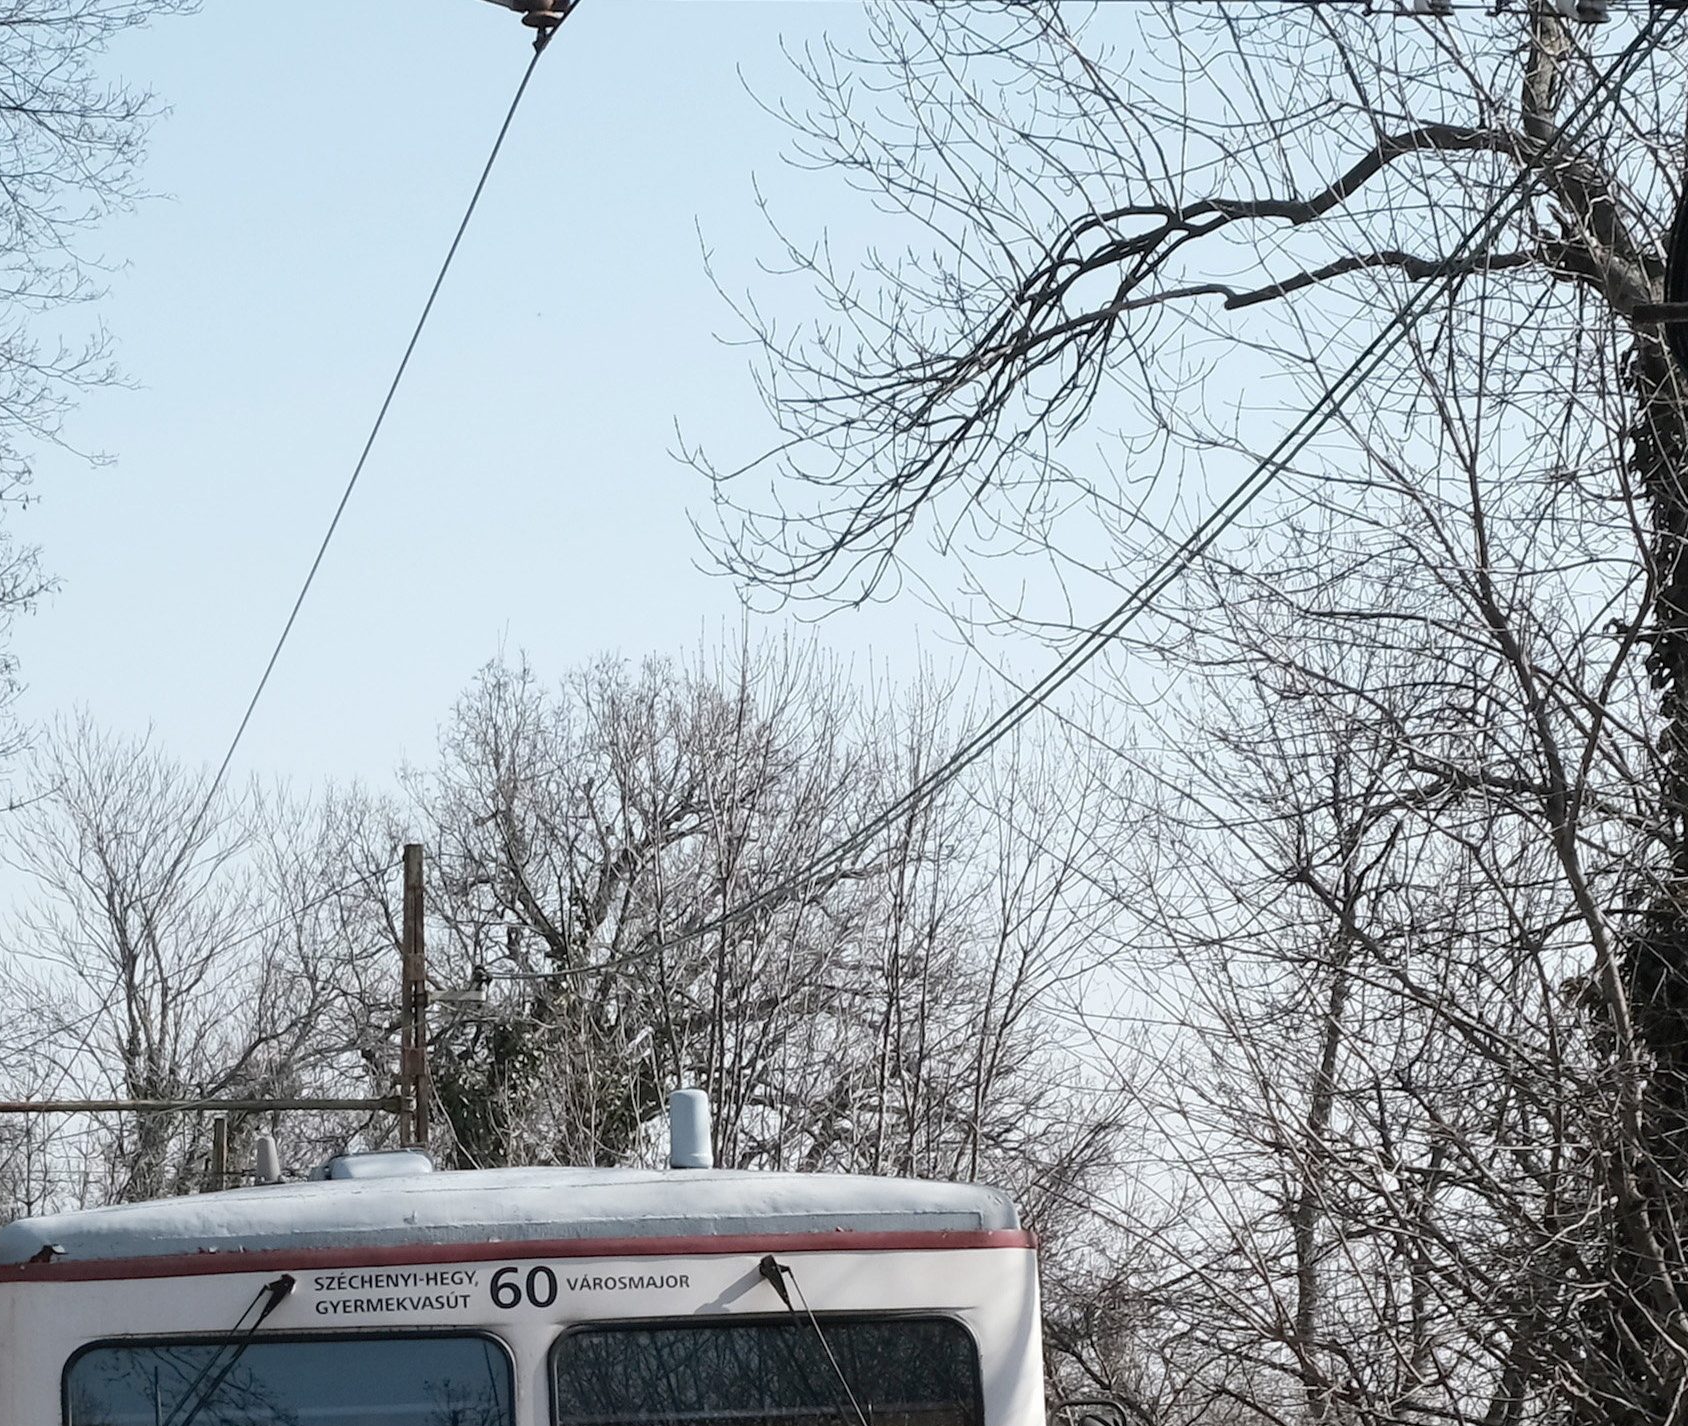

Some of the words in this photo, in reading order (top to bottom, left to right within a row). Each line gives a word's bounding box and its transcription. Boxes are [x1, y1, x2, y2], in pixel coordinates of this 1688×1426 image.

[314, 1270, 479, 1291] SZÉCHENYI-HEGY,
[489, 1265, 558, 1309] 60
[566, 1274, 691, 1291] VÁROSMAJOR
[315, 1291, 470, 1315] GYERMEKVASÚT
